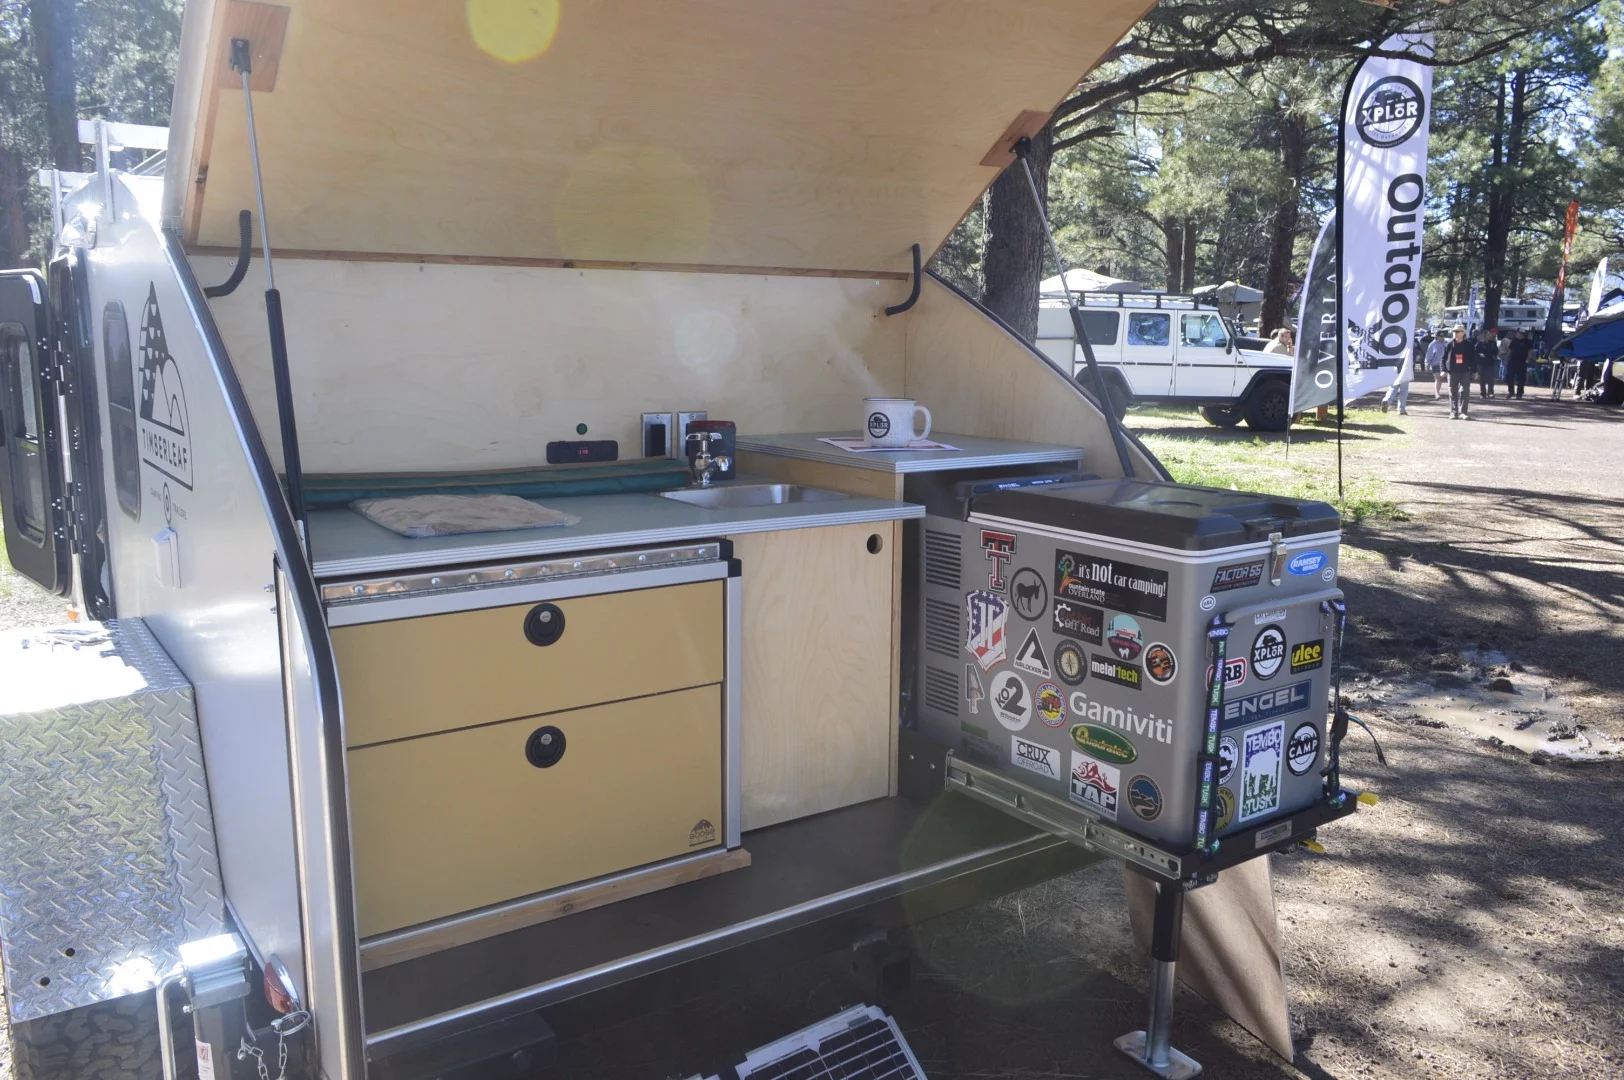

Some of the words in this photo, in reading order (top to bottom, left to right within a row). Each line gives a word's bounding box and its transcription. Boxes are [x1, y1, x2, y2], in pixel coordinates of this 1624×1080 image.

[142, 428, 188, 472] TIMBERLEAF
[1292, 556, 1322, 568] RAMSEY
[1092, 563, 1112, 584] not
[1114, 575, 1127, 588] car
[1128, 579, 1167, 598] camping!
[1214, 568, 1249, 584] FACTOR
[1249, 563, 1264, 578] 55
[1068, 588, 1106, 603] OVERLAND
[1090, 587, 1106, 597] state
[1080, 623, 1101, 637] Road
[1293, 644, 1321, 663] slee
[1091, 661, 1116, 678] metal
[1115, 667, 1139, 684] tech
[1224, 664, 1243, 683] RB
[1225, 687, 1304, 720] ENGEL
[1069, 691, 1173, 745] Gamiviti
[1246, 728, 1282, 752] TEMBO
[1289, 740, 1318, 758] CAMP
[1016, 741, 1052, 764] CRUX
[1017, 756, 1050, 774] OFFROAD
[1203, 761, 1212, 782] EMBO
[1072, 778, 1116, 810] TAP
[1201, 784, 1209, 804] TUSK
[1246, 793, 1274, 813] TUSK
